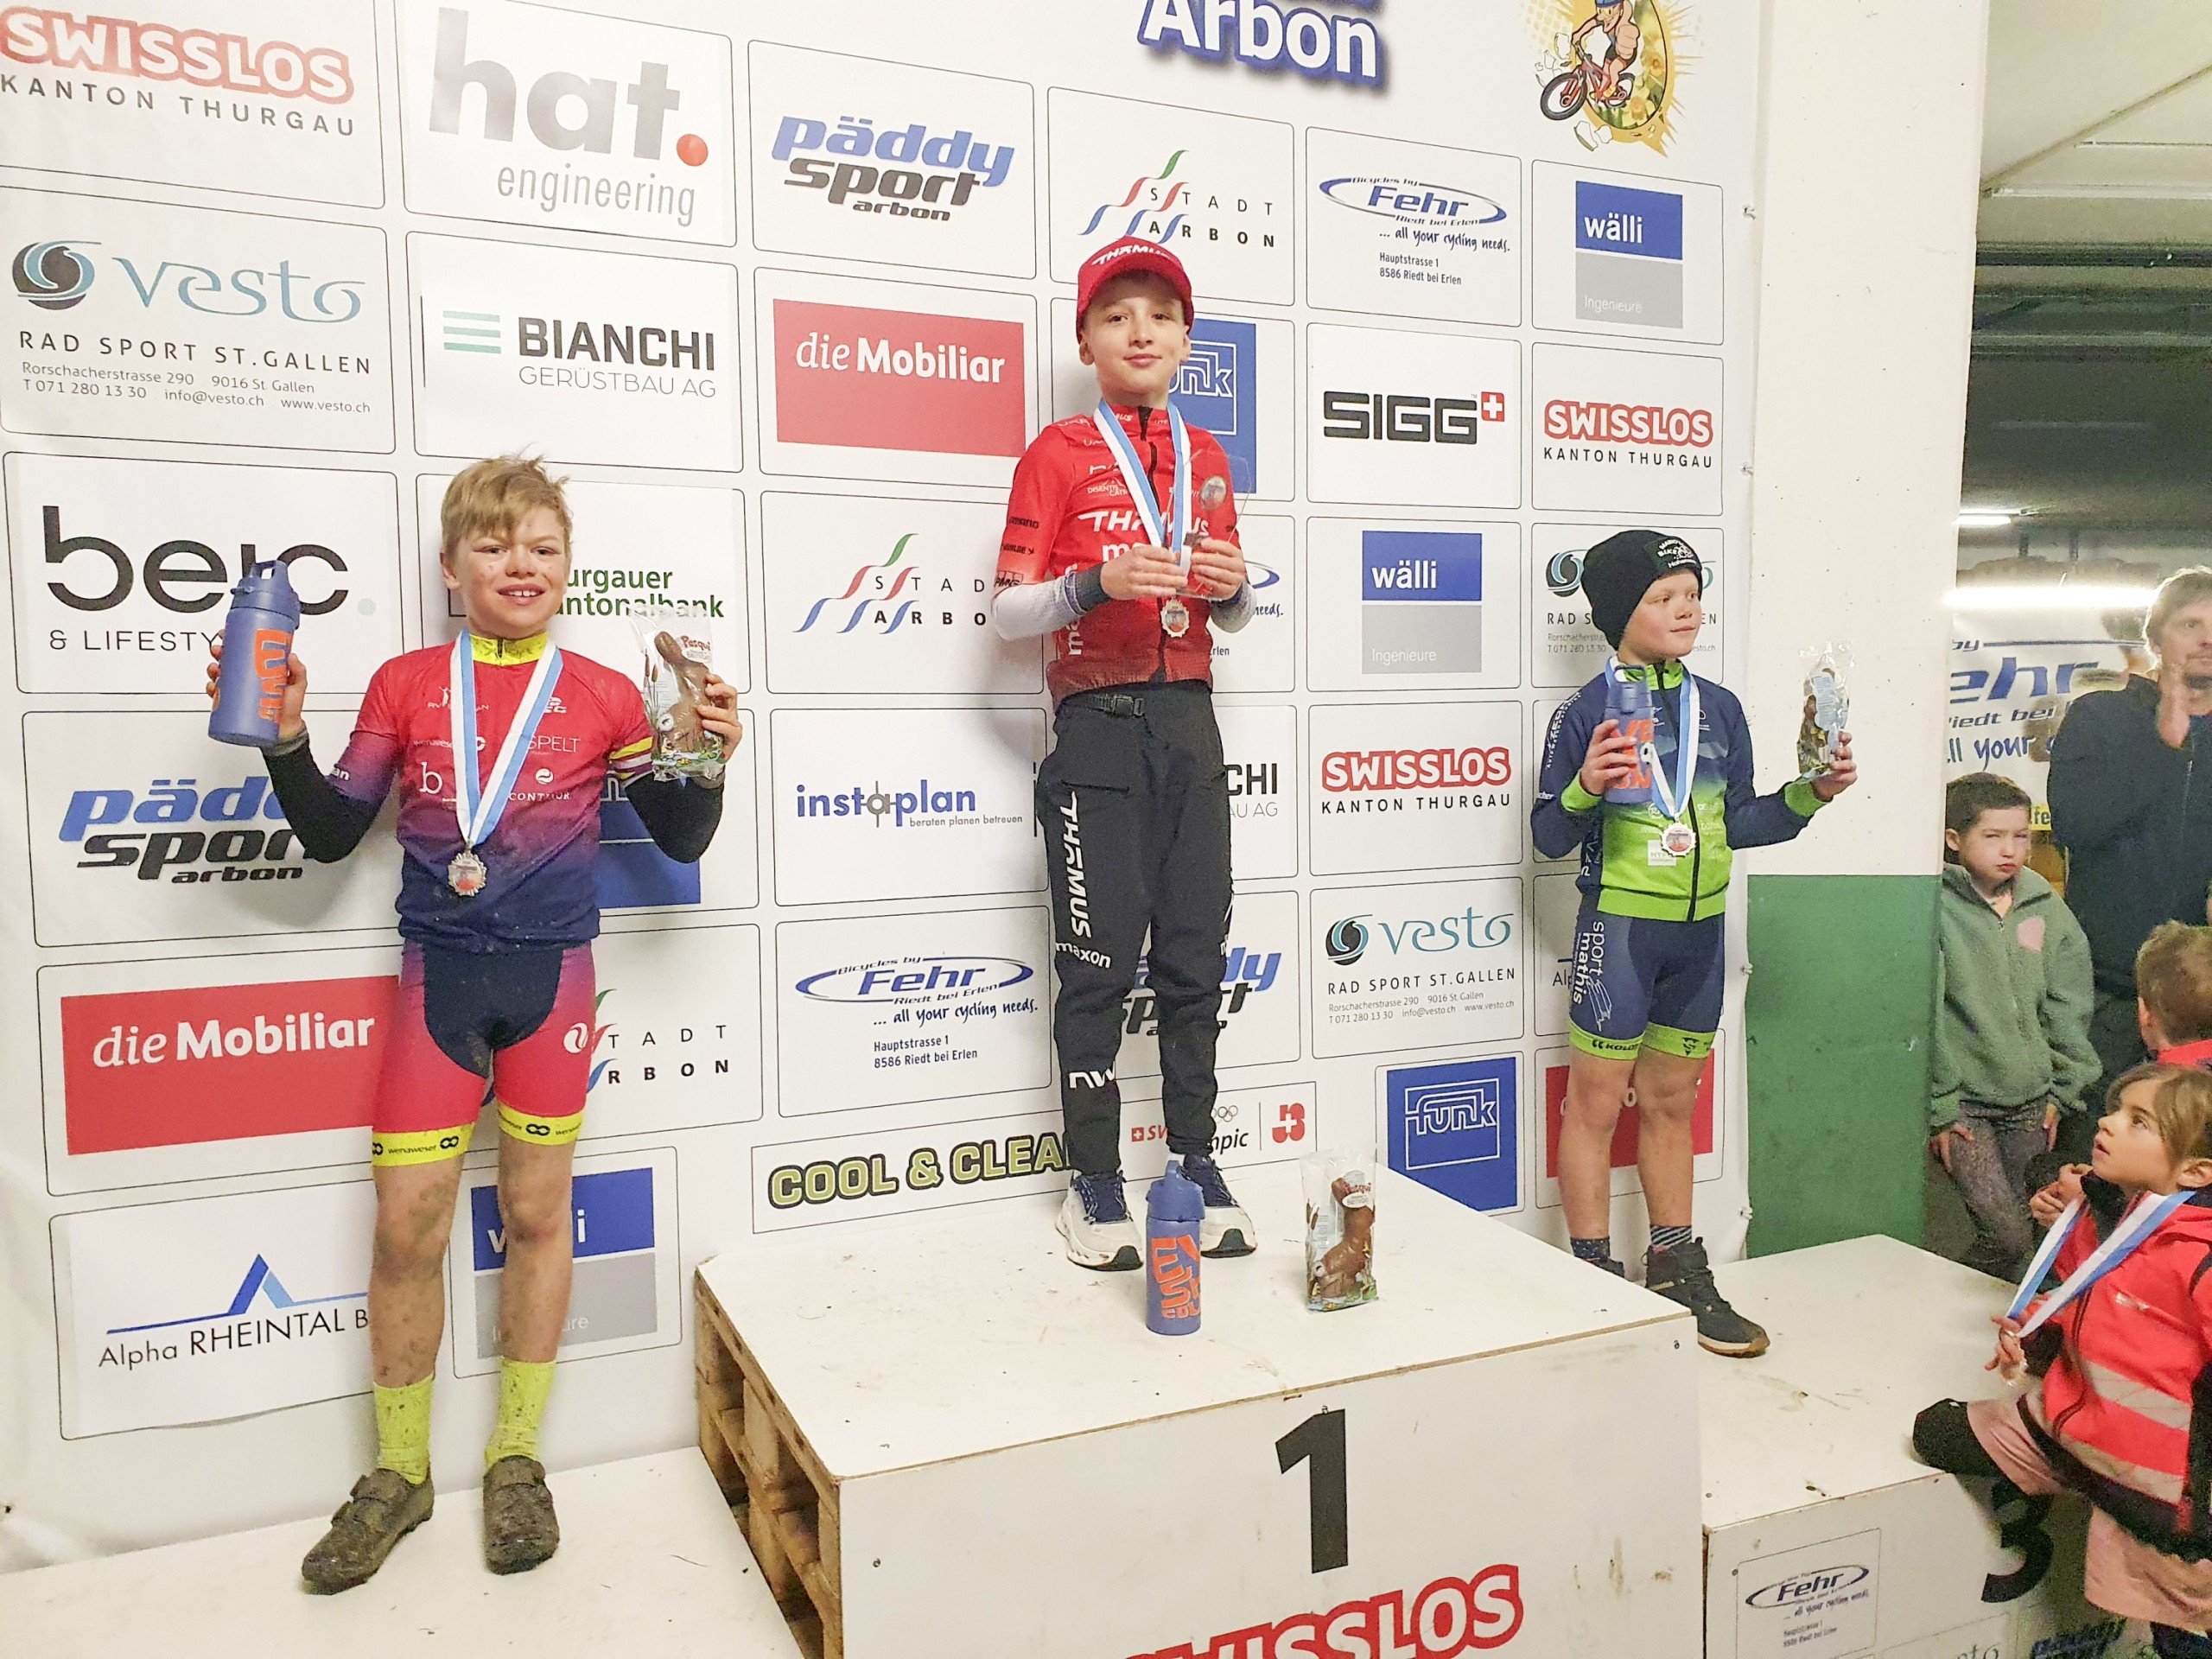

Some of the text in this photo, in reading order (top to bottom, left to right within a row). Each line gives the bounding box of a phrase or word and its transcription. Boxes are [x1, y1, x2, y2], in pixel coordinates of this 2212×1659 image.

[0, 7, 354, 105] SWISSLOS
[1139, 0, 1382, 85] Arbon
[1, 73, 354, 137] KANTON THURGAU
[772, 116, 1014, 187] päddy
[498, 163, 695, 226] engineering
[784, 158, 980, 206] sport
[853, 200, 950, 221] arbon
[1151, 188, 1274, 216] STADT
[1368, 186, 1468, 216] Fehr
[1149, 221, 1275, 247] ARBON
[1395, 227, 1408, 239] all
[1414, 230, 1440, 246] your
[1444, 234, 1478, 251] cycling
[1585, 213, 1643, 243] wälli
[1380, 252, 1440, 268] Hauptstrasse 1
[112, 257, 365, 323] vesto
[1379, 268, 1462, 285] 8586 Riedt bei Erlen
[1585, 296, 1642, 313] Ingenieure
[19, 330, 80, 353] RAD
[99, 337, 196, 360] SPORT
[518, 316, 715, 371] BIANCHI
[796, 332, 1005, 383] die Mobiliar
[22, 361, 315, 394] Rorschacherstrasse 290 9016 St. Gallen
[519, 366, 715, 397] GERÜSTBAU AG
[23, 378, 371, 413] T 071 280 13 30 info@vesto.ch www.vesto.ch
[1324, 391, 1478, 444] SIGG
[1544, 399, 1713, 448] SWISSLOS
[1543, 447, 1712, 467] KANTON THURGAU
[568, 568, 673, 594] urgauer
[875, 575, 985, 593] STAD
[1371, 560, 1437, 589] wälli
[874, 611, 987, 626] ARBO
[1548, 613, 1576, 625] RAD
[49, 629, 225, 652] & LIFESTY
[1371, 649, 1437, 666] Ingenieure
[1948, 712, 2001, 728] iedt
[1974, 736, 2034, 771] your
[1322, 747, 1511, 792] SWISSLOS
[59, 776, 286, 842] päd
[797, 779, 976, 827] instaplan
[1253, 801, 1278, 817] AG
[1322, 794, 1510, 814] KANTON THURGAU
[910, 814, 1022, 827] beraten planen betreuen
[77, 829, 298, 880] spor
[172, 866, 302, 883] arbon
[1377, 906, 1514, 955] vesto
[1055, 941, 1111, 969] maxon
[1589, 921, 1605, 976] sport
[837, 956, 921, 976] Bicycles by
[857, 965, 986, 995] Fehr
[1572, 932, 1592, 1005] mathis
[893, 984, 999, 1005] Riedt bei Erlen
[1328, 981, 1360, 995] RAD
[1370, 975, 1421, 991] SPORT
[893, 998, 1038, 1027] all your cycling needs.
[1329, 998, 1402, 1012] Rorschacherstrasse
[1403, 997, 1419, 1006] 290
[1427, 995, 1448, 1003] 9016
[1460, 991, 1484, 1001] Gallen
[1335, 1014, 1351, 1024] 071
[1353, 1013, 1369, 1022] 280
[1371, 1012, 1381, 1020] 13
[1382, 1010, 1393, 1020] 30
[1402, 1005, 1456, 1018] info@vesto.ch
[1464, 1000, 1514, 1012] www.vesto.ch
[93, 1012, 375, 1067] die Mobiliar
[607, 1025, 727, 1049] TADT
[874, 1035, 949, 1052] Hauptstrasse 1
[607, 1059, 729, 1084] RBON
[874, 1049, 977, 1069] 8586 Riedt bei Erlen
[1406, 1089, 1497, 1135] funk
[768, 1132, 1066, 1209] COOL & CLEA
[99, 1340, 177, 1370] Alpha
[191, 1308, 346, 1356] RHEINTAL
[1275, 1408, 1348, 1573] 1
[1980, 1473, 2053, 1603] 3
[1777, 1573, 1844, 1602] Fehr
